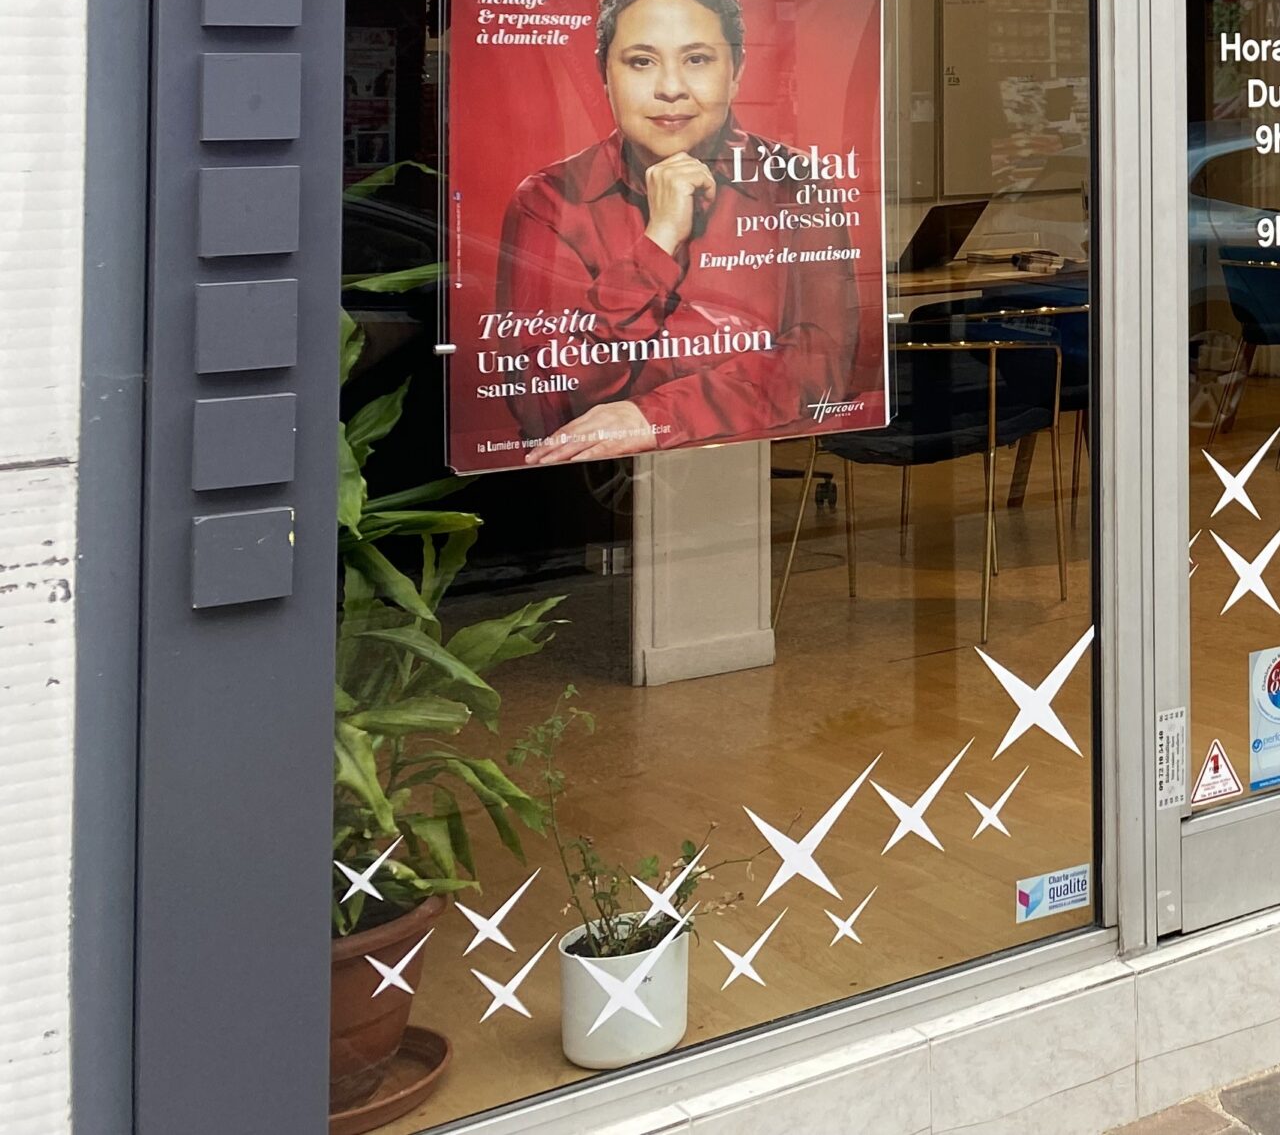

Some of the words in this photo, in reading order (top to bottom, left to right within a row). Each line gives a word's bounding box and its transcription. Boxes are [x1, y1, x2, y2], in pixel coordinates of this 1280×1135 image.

[477, 10, 495, 25] &
[498, 13, 591, 30] repassage
[477, 29, 488, 45] à
[492, 29, 569, 45] domicile
[731, 146, 860, 183] L'éclat
[796, 184, 860, 204] d'une
[737, 207, 860, 237] profession
[700, 250, 775, 270] Employé
[777, 248, 797, 263] de
[800, 246, 861, 262] maison
[478, 309, 597, 339] Térésita
[477, 349, 529, 374] Une
[537, 326, 773, 369] détermination
[477, 380, 526, 399] sans
[531, 374, 579, 395] faille
[807, 386, 864, 423] Harcourt
[487, 439, 520, 452] Lumière
[521, 437, 542, 448] vient
[1049, 874, 1068, 884] Charte
[1049, 876, 1087, 902] qualité
